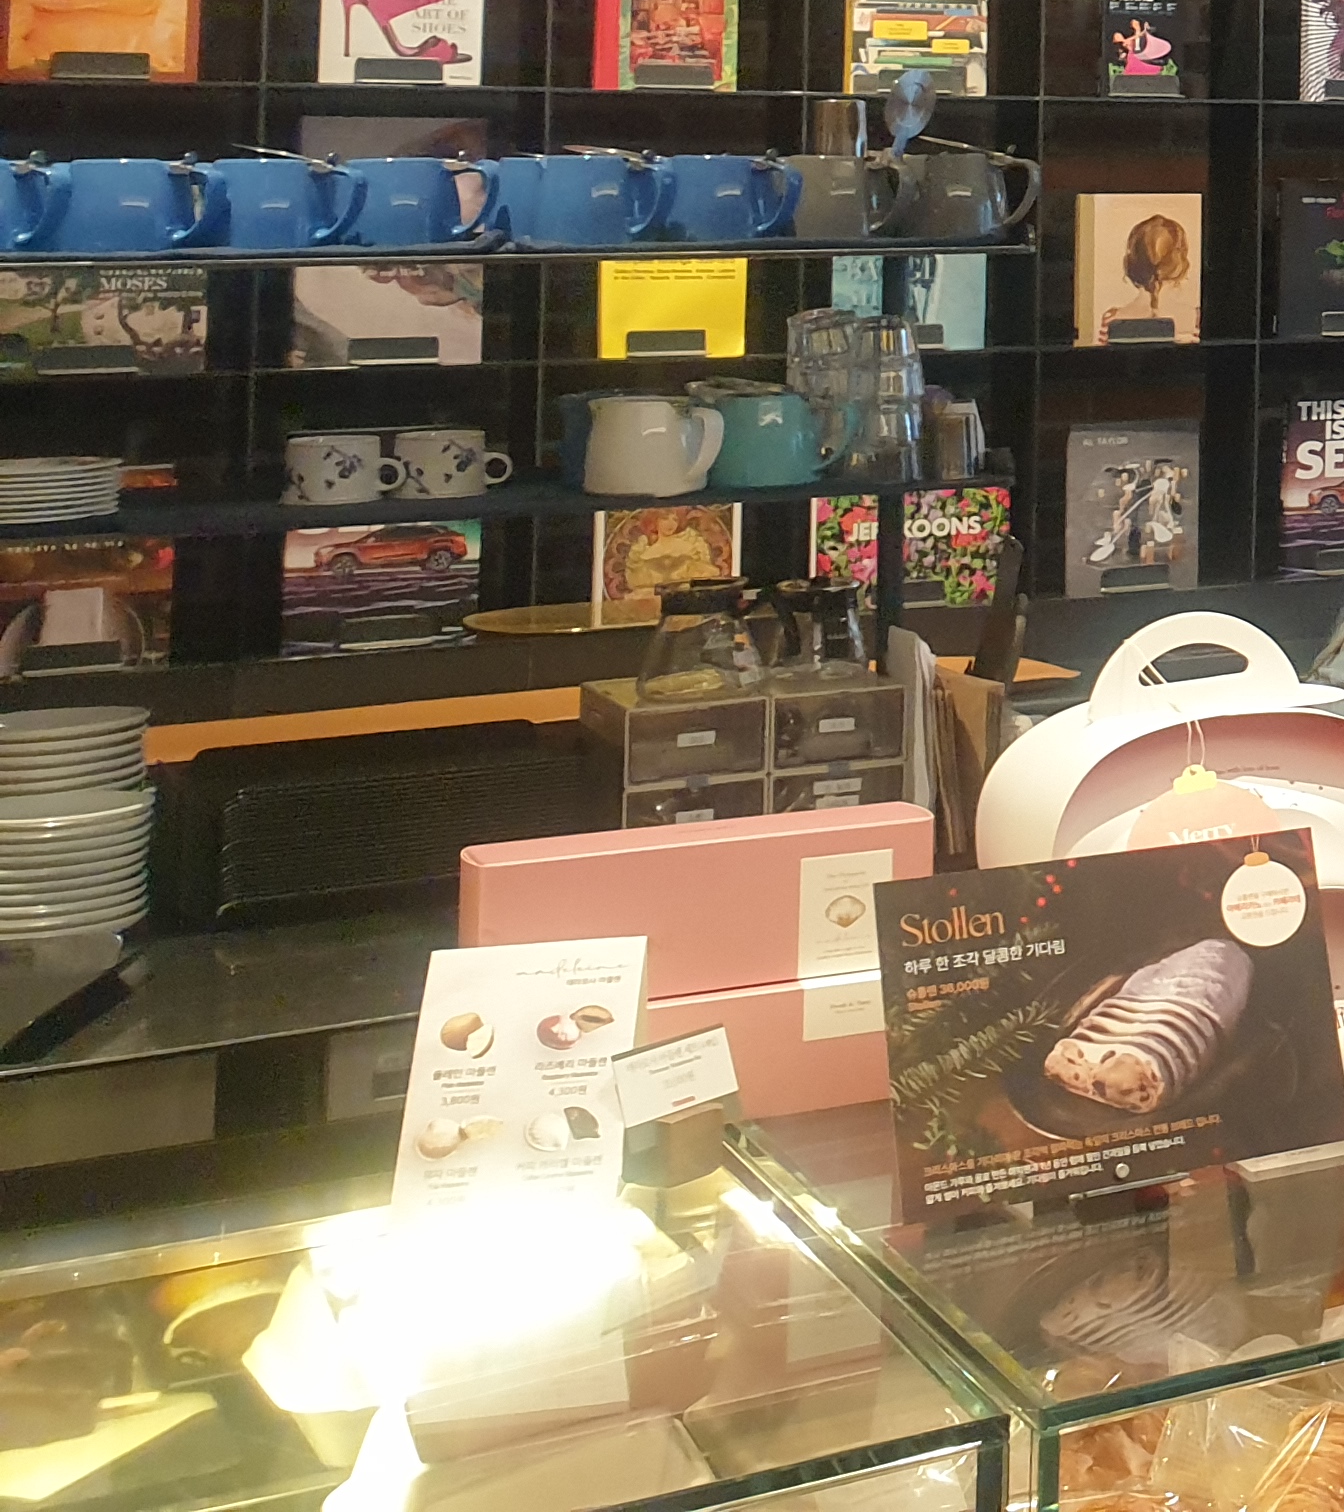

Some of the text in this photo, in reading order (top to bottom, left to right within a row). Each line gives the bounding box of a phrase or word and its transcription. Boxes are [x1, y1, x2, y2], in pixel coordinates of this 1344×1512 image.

[447, 9, 469, 21] OF
[410, 21, 467, 35] SHOES
[101, 276, 167, 291] MOSES
[900, 905, 1005, 948] Stollen
[903, 938, 1067, 976] 하루 한 조각 달콤한 기다림
